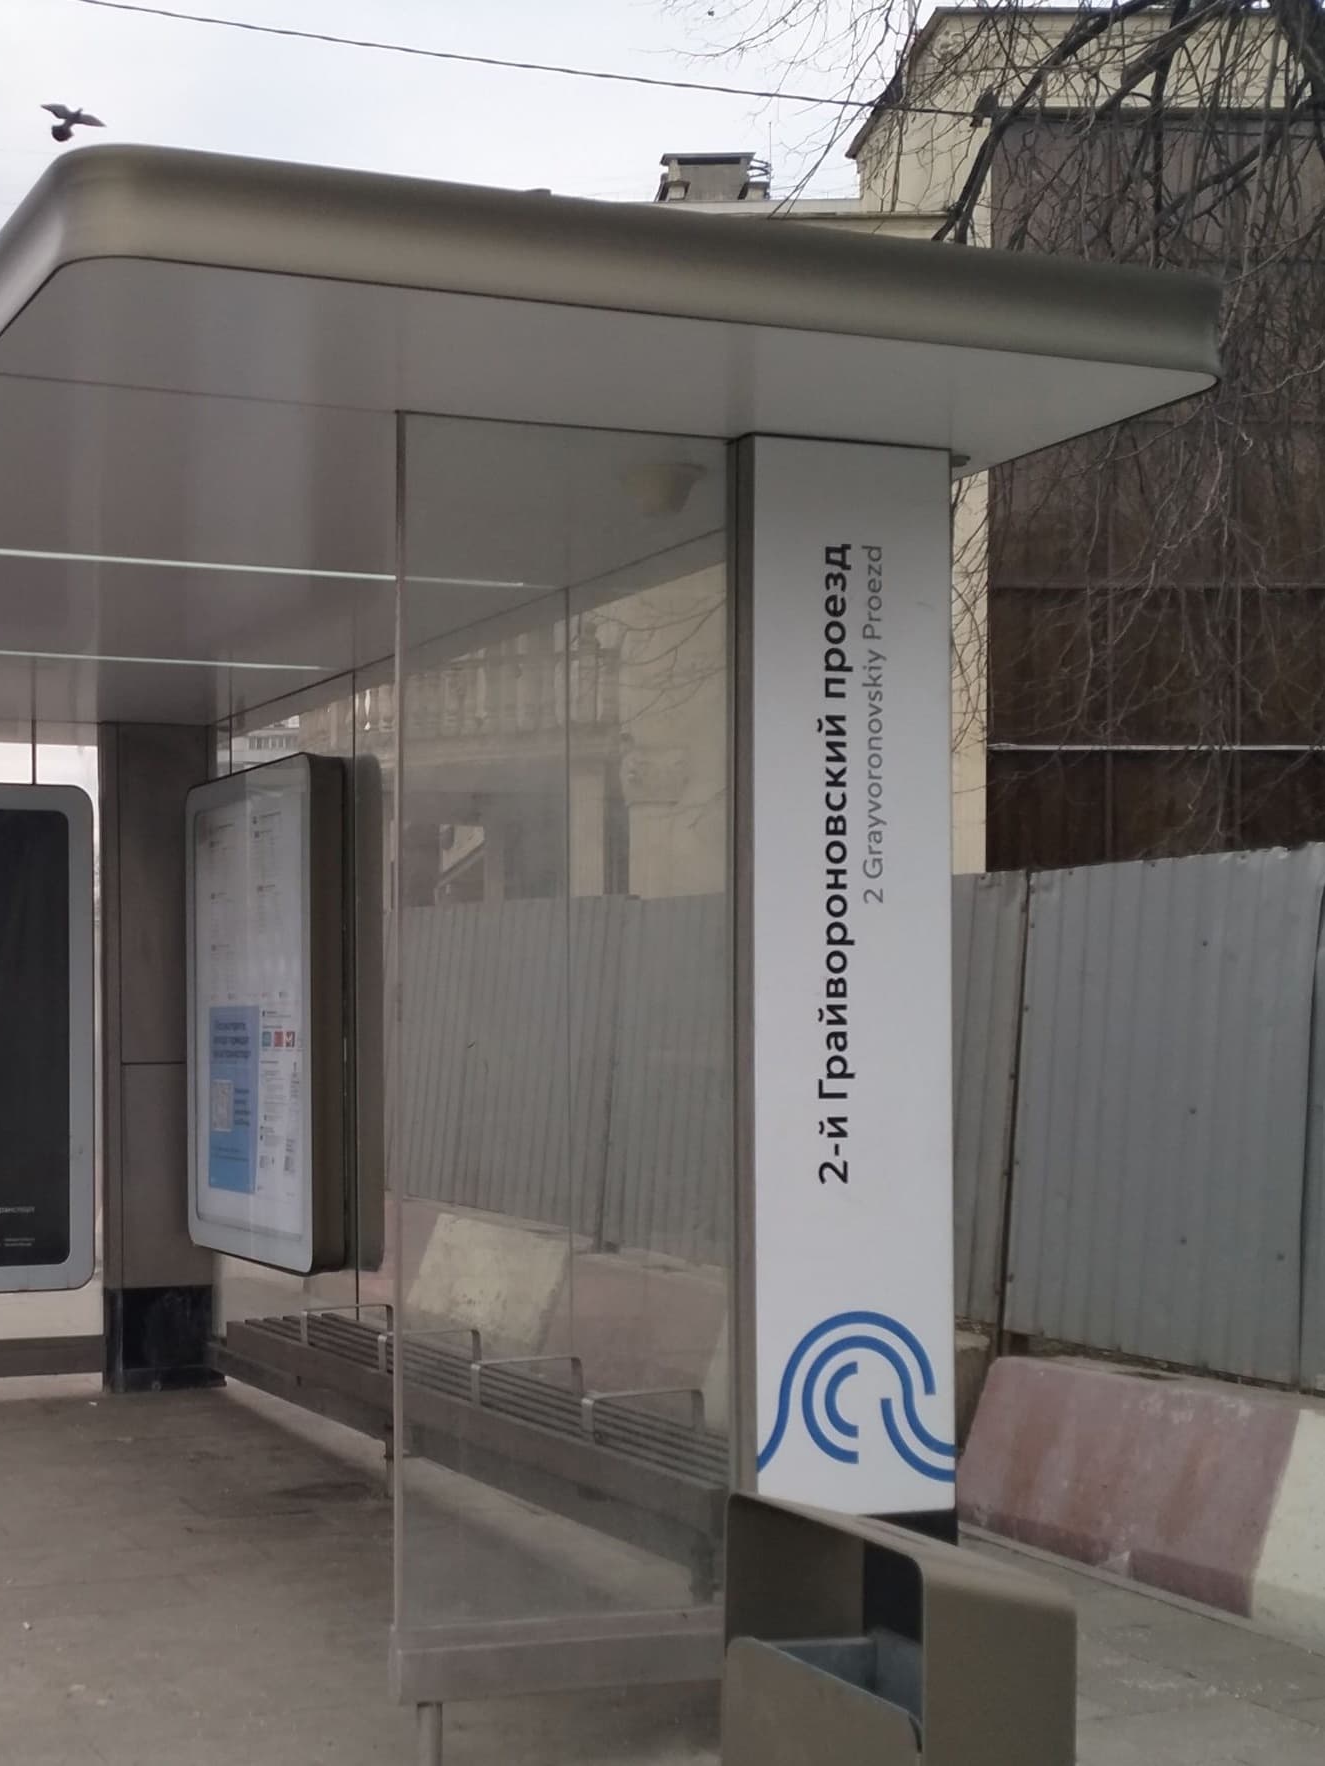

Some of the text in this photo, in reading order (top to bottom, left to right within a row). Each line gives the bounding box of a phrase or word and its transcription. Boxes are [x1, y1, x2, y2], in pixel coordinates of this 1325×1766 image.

[817, 543, 855, 1184] 2-й Грайвороновский проезд
[862, 545, 887, 904] 2 Grayvoronovskiy Proezd
